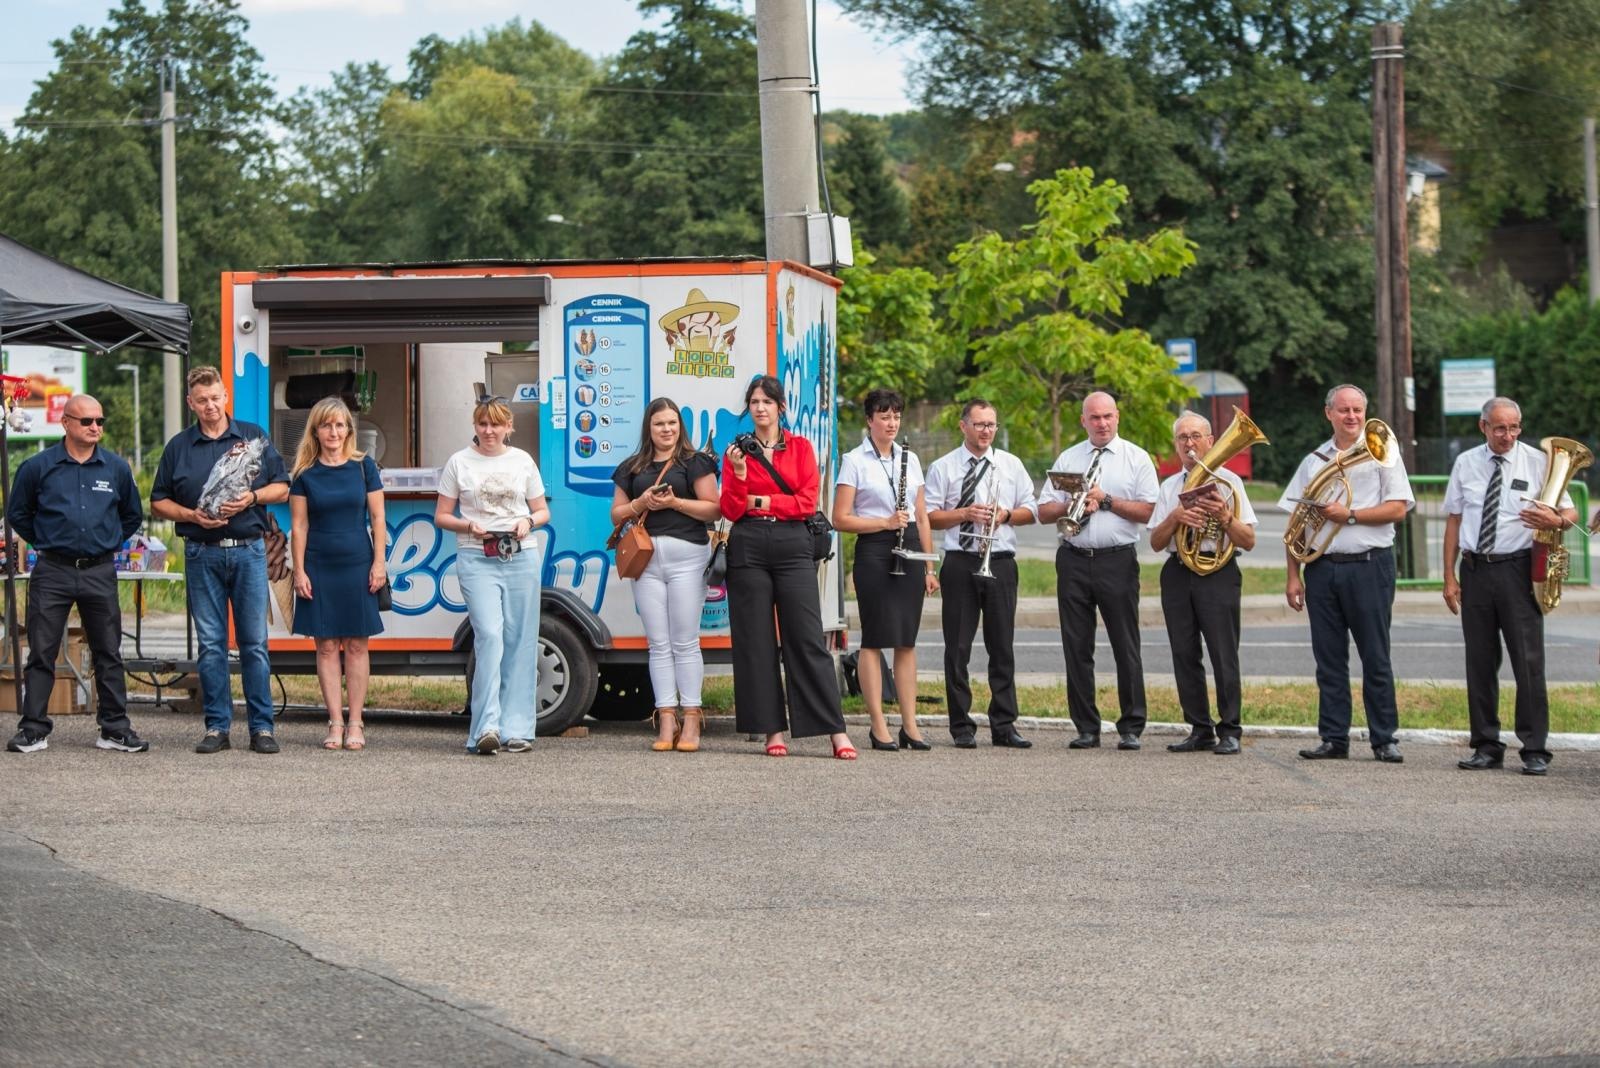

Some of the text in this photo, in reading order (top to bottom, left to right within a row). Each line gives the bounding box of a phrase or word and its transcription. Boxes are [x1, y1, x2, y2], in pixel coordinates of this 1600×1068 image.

[591, 298, 622, 306] CENNIK
[592, 315, 622, 323] CENNIK
[600, 339, 609, 348] 10
[677, 351, 727, 364] LODY
[600, 366, 609, 374] 16
[669, 363, 733, 377] DIEGO
[520, 387, 540, 398] CA
[600, 385, 609, 393] 15
[600, 398, 609, 406] 16
[601, 443, 609, 451] 14
